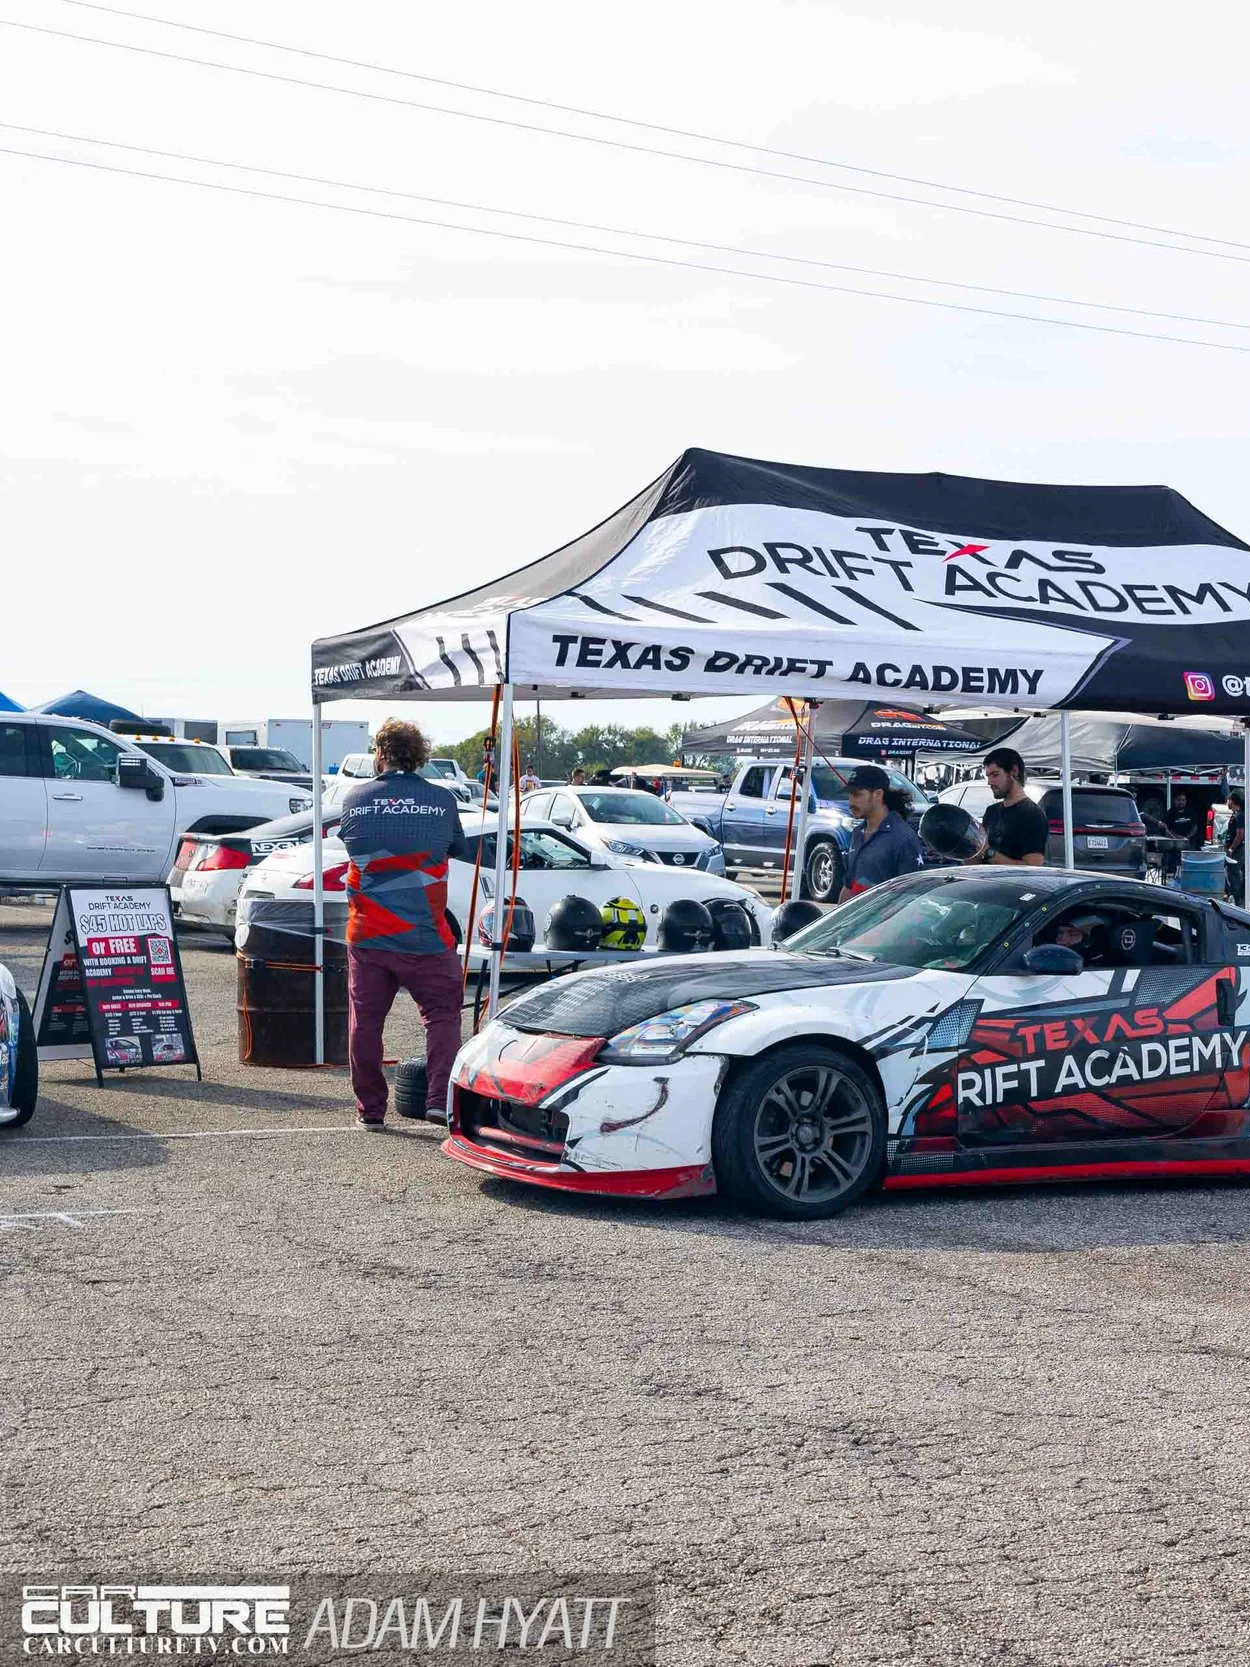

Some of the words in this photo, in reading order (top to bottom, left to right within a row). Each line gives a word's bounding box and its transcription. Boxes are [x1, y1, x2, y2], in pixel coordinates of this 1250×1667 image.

[855, 526, 1106, 574] TEXAS
[707, 542, 914, 592] DRIFT
[314, 666, 341, 685] TEXAS
[341, 662, 365, 682] DRIFT
[365, 655, 401, 678] ACADEMY
[552, 634, 695, 672] TEXAS
[703, 650, 834, 679] DRIFT
[841, 662, 1045, 695] ACADEMY
[858, 736, 890, 746] DRAG
[349, 806, 380, 817] DRIFT
[381, 805, 446, 817] ACADEMY
[373, 798, 415, 806] TEXAS
[113, 902, 151, 910] ACADEMY
[80, 914, 107, 934] $45
[108, 914, 135, 932] HOT
[135, 913, 167, 931] LAPS
[92, 942, 105, 955] or
[109, 938, 136, 954] FREE
[85, 968, 112, 977] ACADEMY
[1016, 1008, 1163, 1054] TEXAS
[957, 1060, 1046, 1107] RIFT
[1054, 1031, 1248, 1093] ACADEMY
